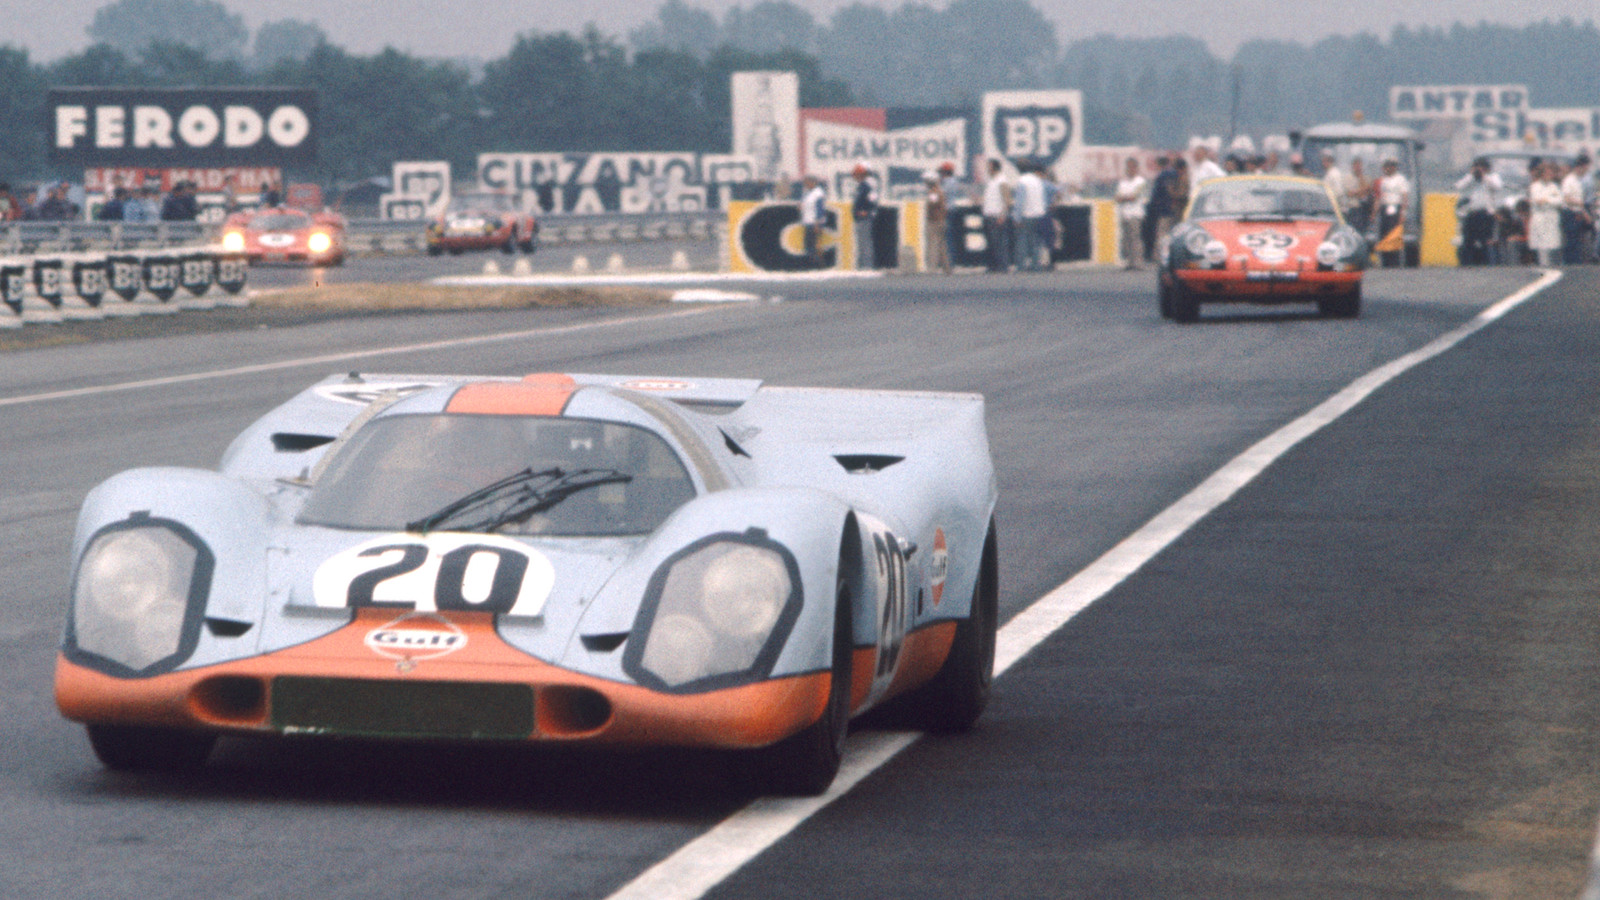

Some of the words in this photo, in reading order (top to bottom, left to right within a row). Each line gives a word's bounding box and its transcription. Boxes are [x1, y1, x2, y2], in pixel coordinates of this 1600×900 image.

[55, 105, 310, 148] FERODO
[1004, 115, 1068, 158] BP
[814, 137, 958, 160] CHAMPION
[346, 542, 531, 614] 20
[872, 531, 905, 678] 20
[373, 631, 459, 646] Gulf
